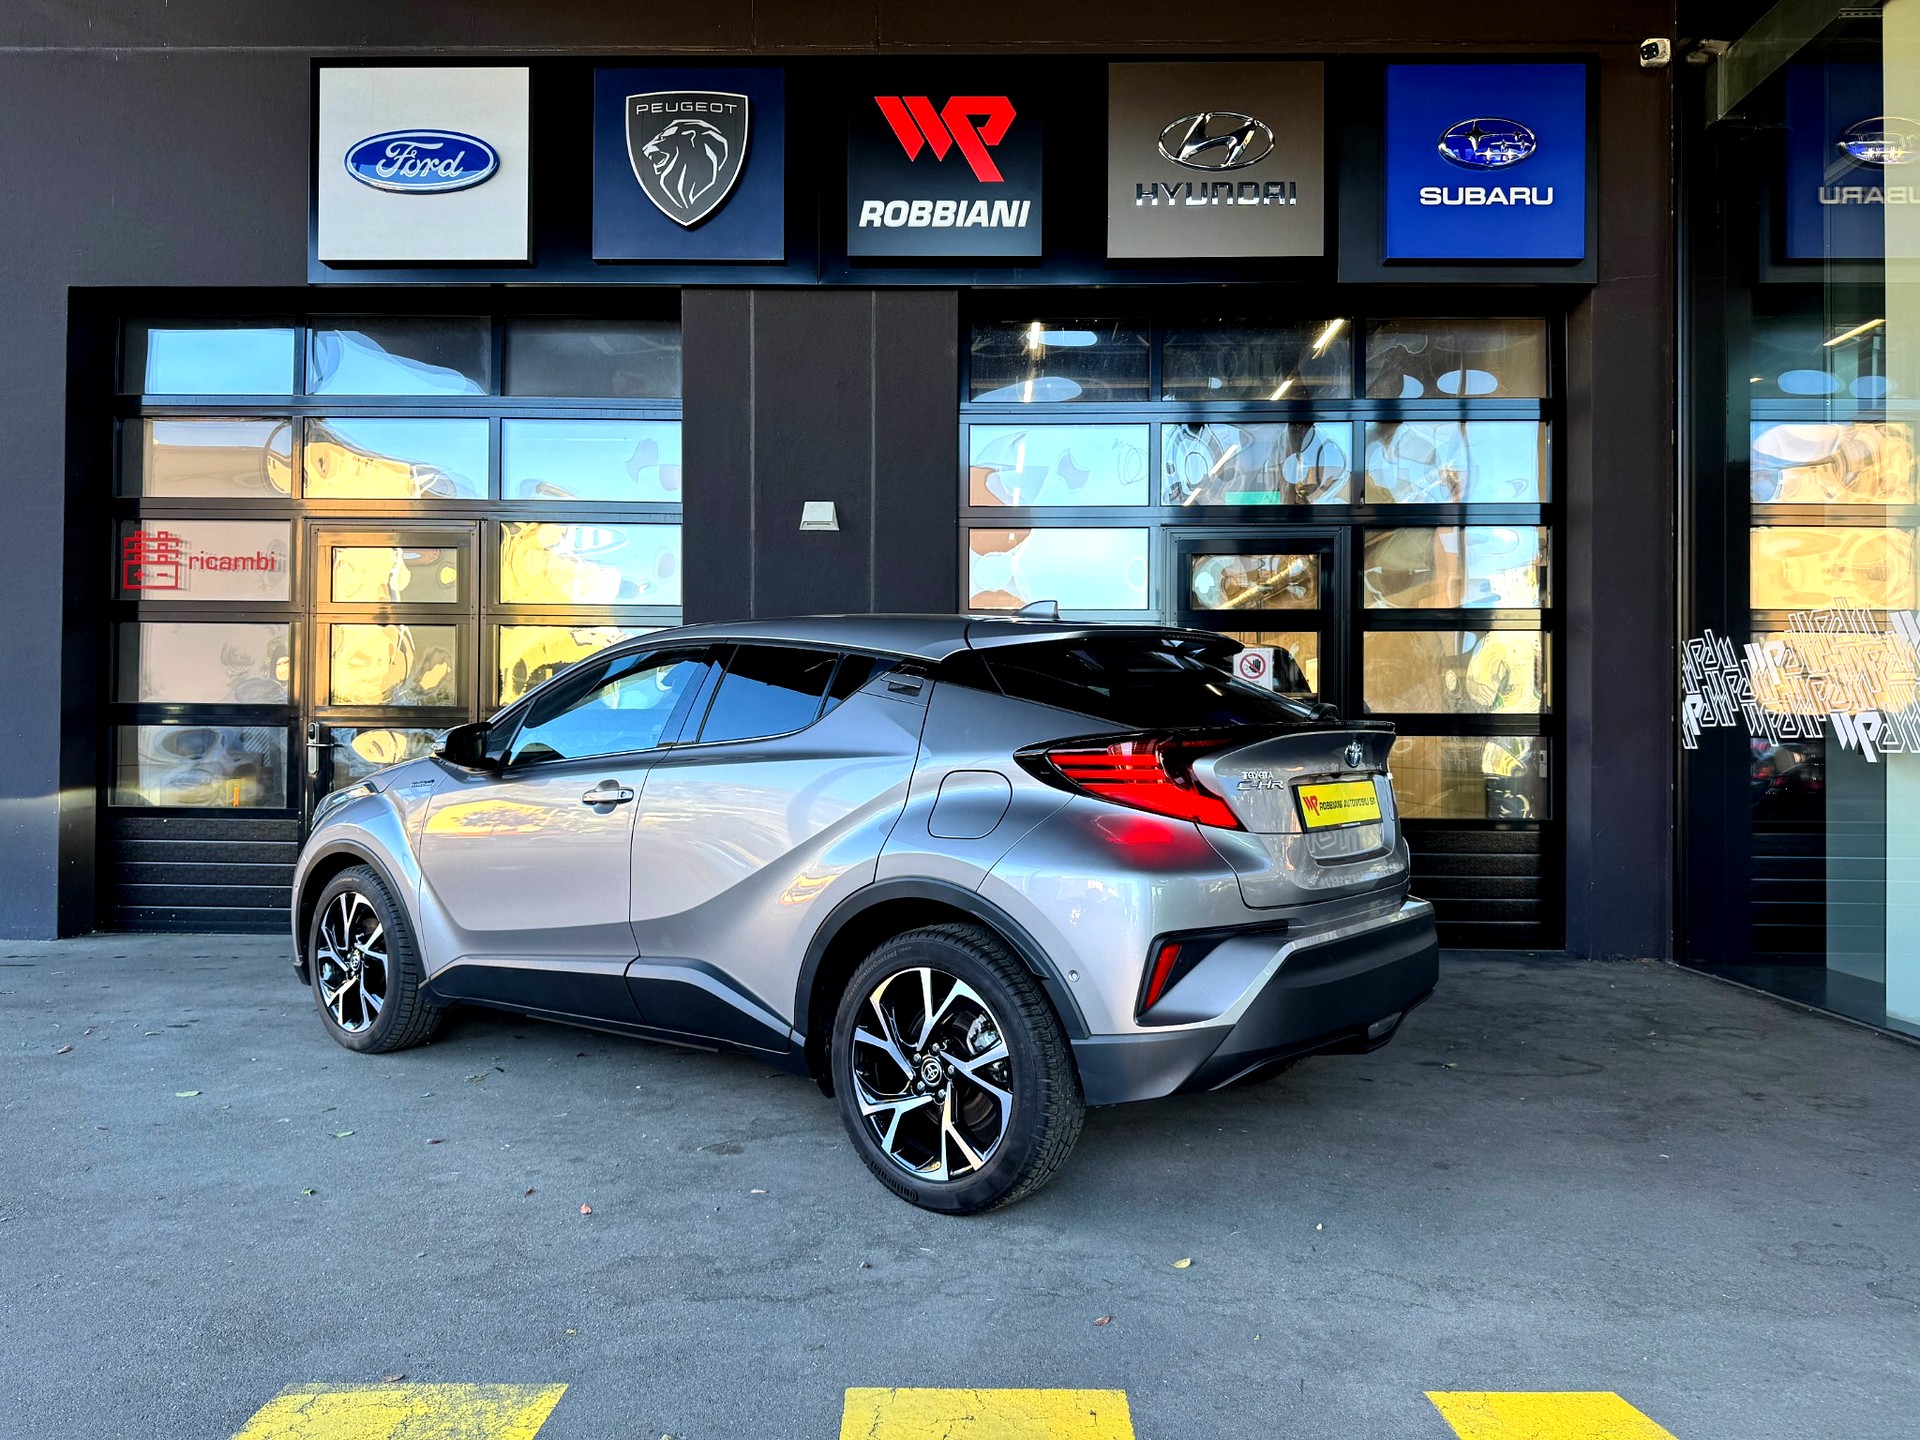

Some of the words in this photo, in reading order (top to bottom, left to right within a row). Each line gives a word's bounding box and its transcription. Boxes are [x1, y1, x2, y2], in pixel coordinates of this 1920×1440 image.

[636, 102, 738, 115] PEUGEOT
[375, 140, 464, 179] Ford
[1135, 182, 1297, 206] HYUNDAI
[1419, 186, 1554, 206] SUBARU
[858, 200, 1031, 228] ROBBIANI
[188, 551, 275, 571] ricambi
[1237, 780, 1284, 790] C-HR
[1241, 771, 1274, 780] TOYOTA
